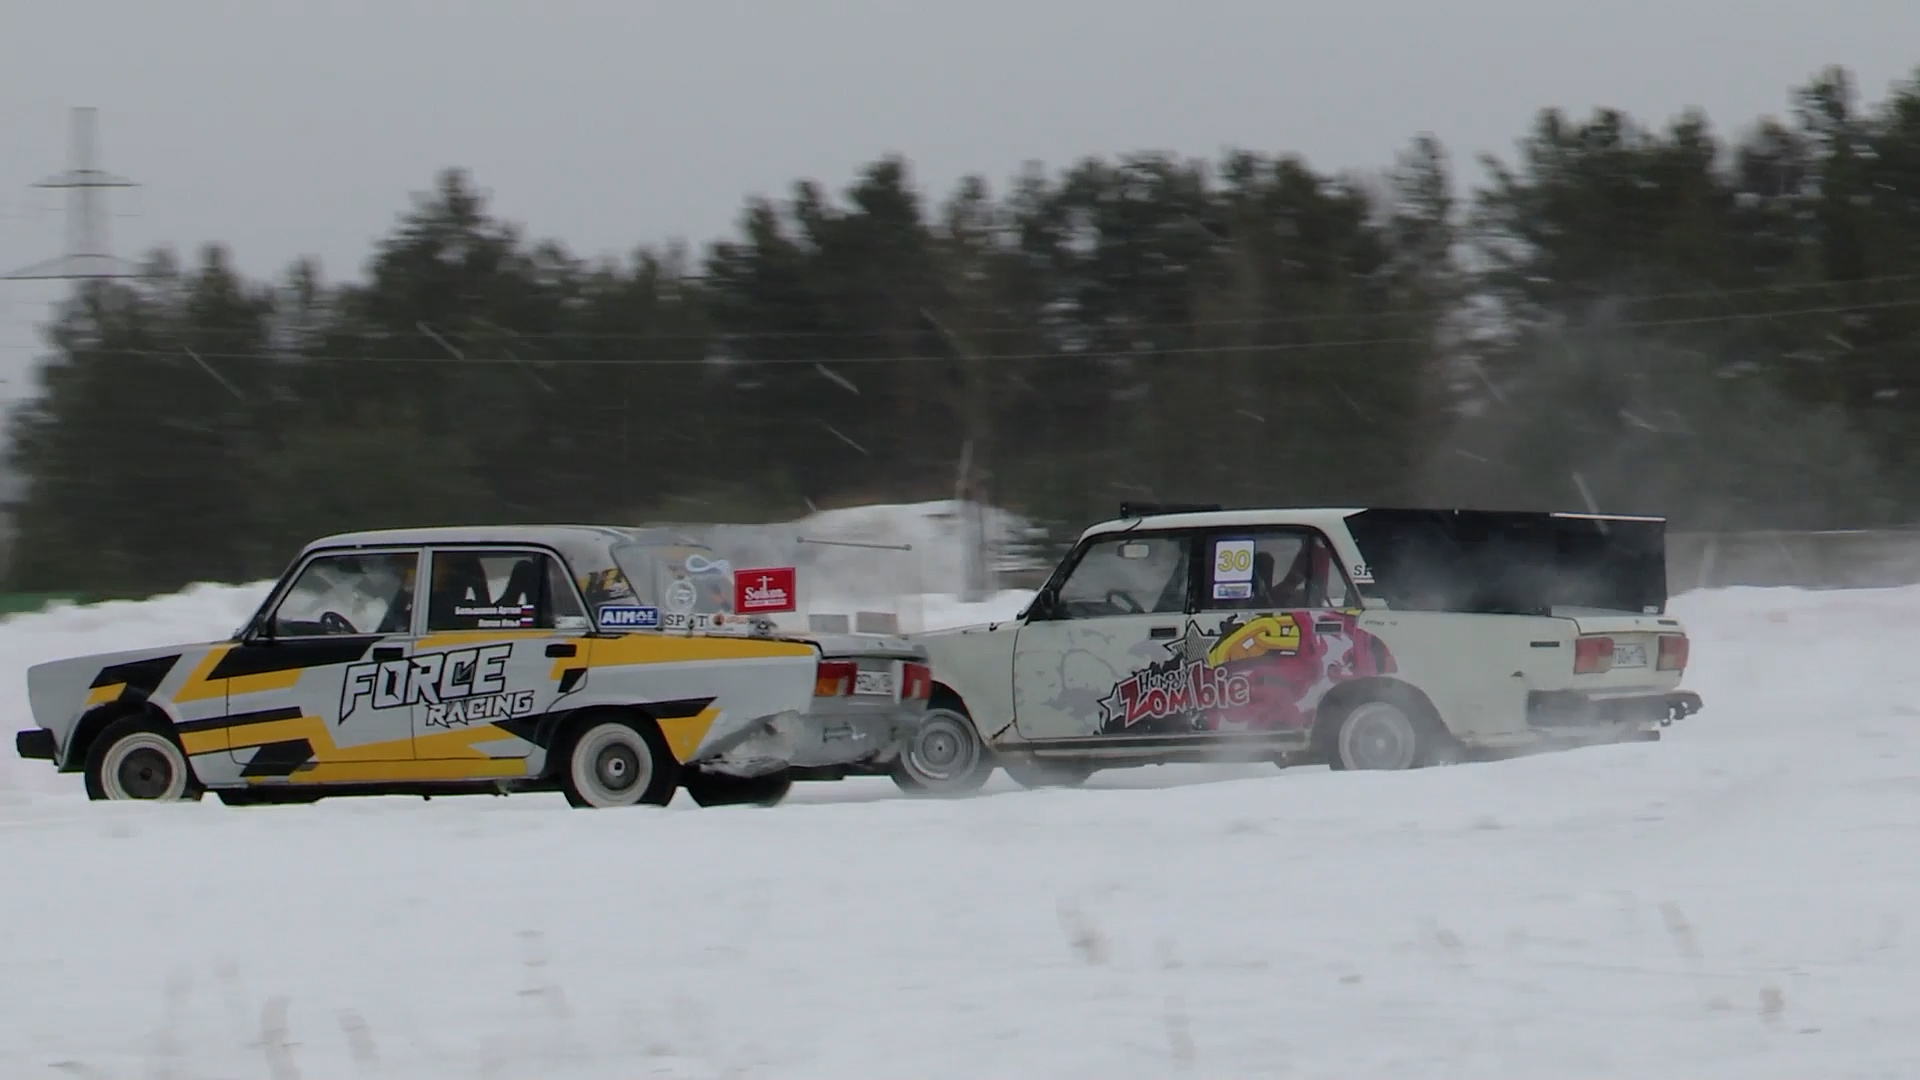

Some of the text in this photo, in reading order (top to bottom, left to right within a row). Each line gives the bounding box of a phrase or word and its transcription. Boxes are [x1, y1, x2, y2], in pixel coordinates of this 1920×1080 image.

[1218, 550, 1251, 572] 30
[602, 610, 656, 624] AIMOL
[338, 642, 514, 726] FORCE
[426, 690, 534, 728] RACING
